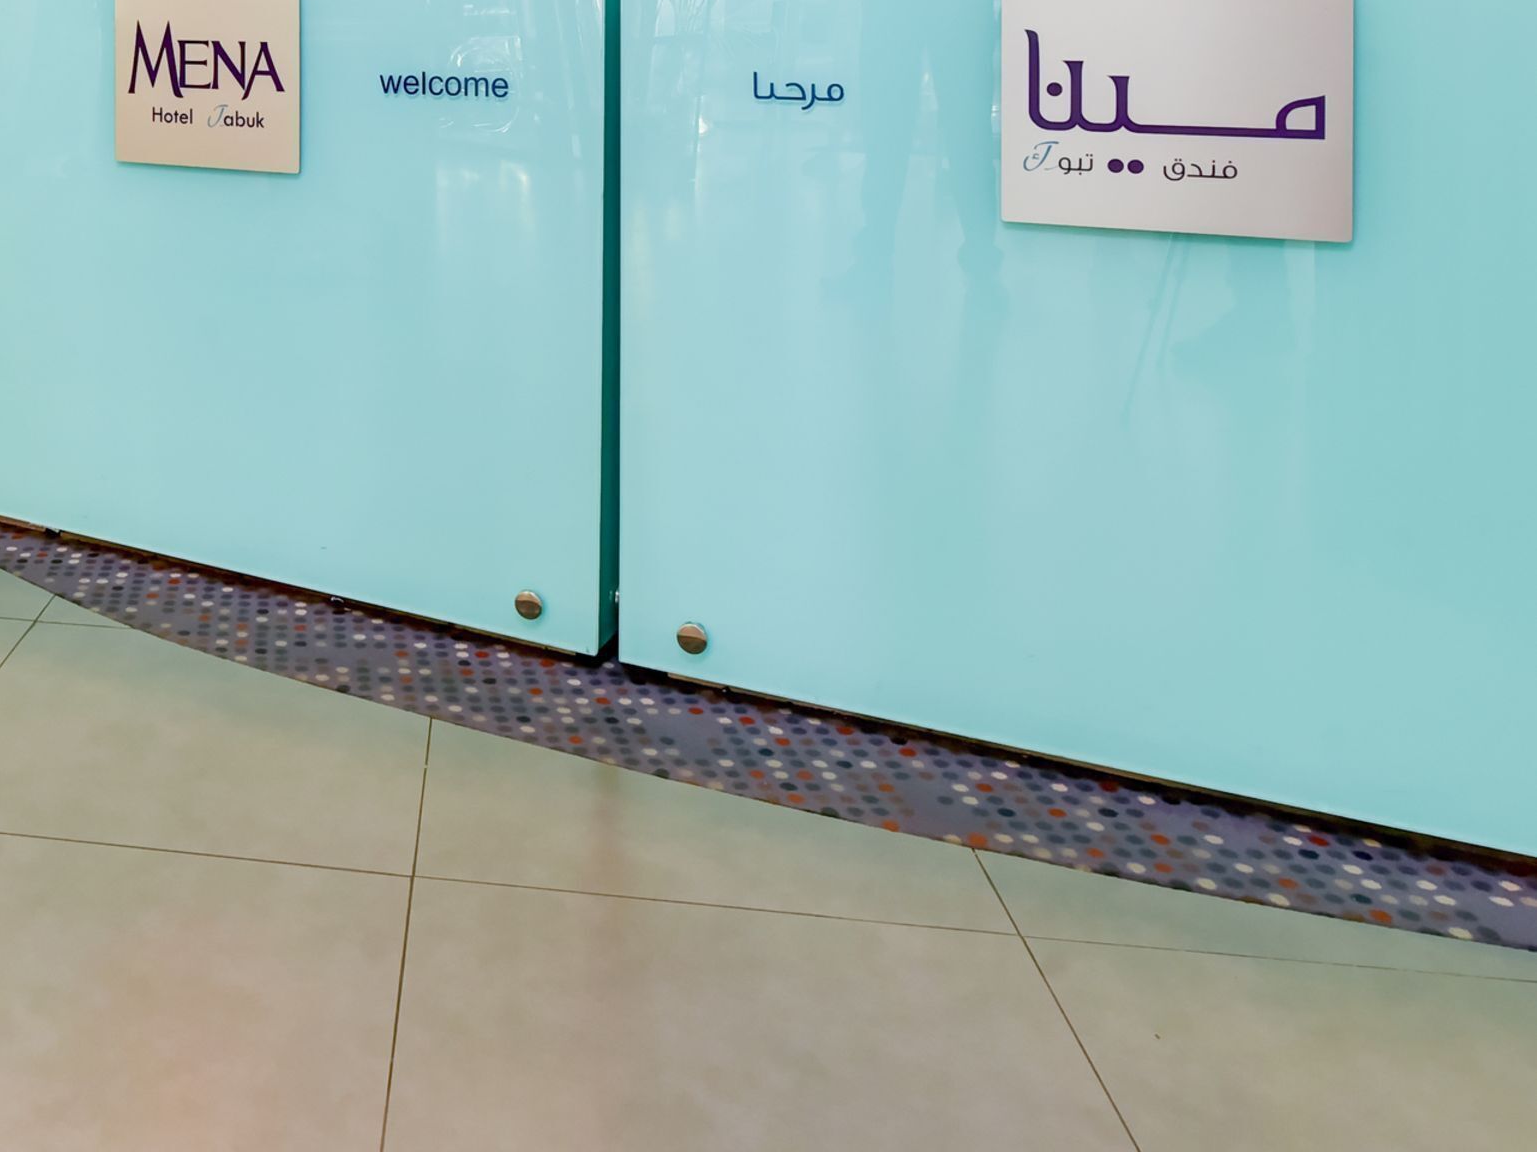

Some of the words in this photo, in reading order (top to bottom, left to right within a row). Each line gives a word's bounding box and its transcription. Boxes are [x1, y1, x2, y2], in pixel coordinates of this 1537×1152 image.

[127, 19, 286, 101] MENA
[379, 70, 510, 99] welcome
[1023, 28, 1327, 141] مينا
[151, 106, 194, 126] Hotel
[1163, 158, 1239, 182] فندق
